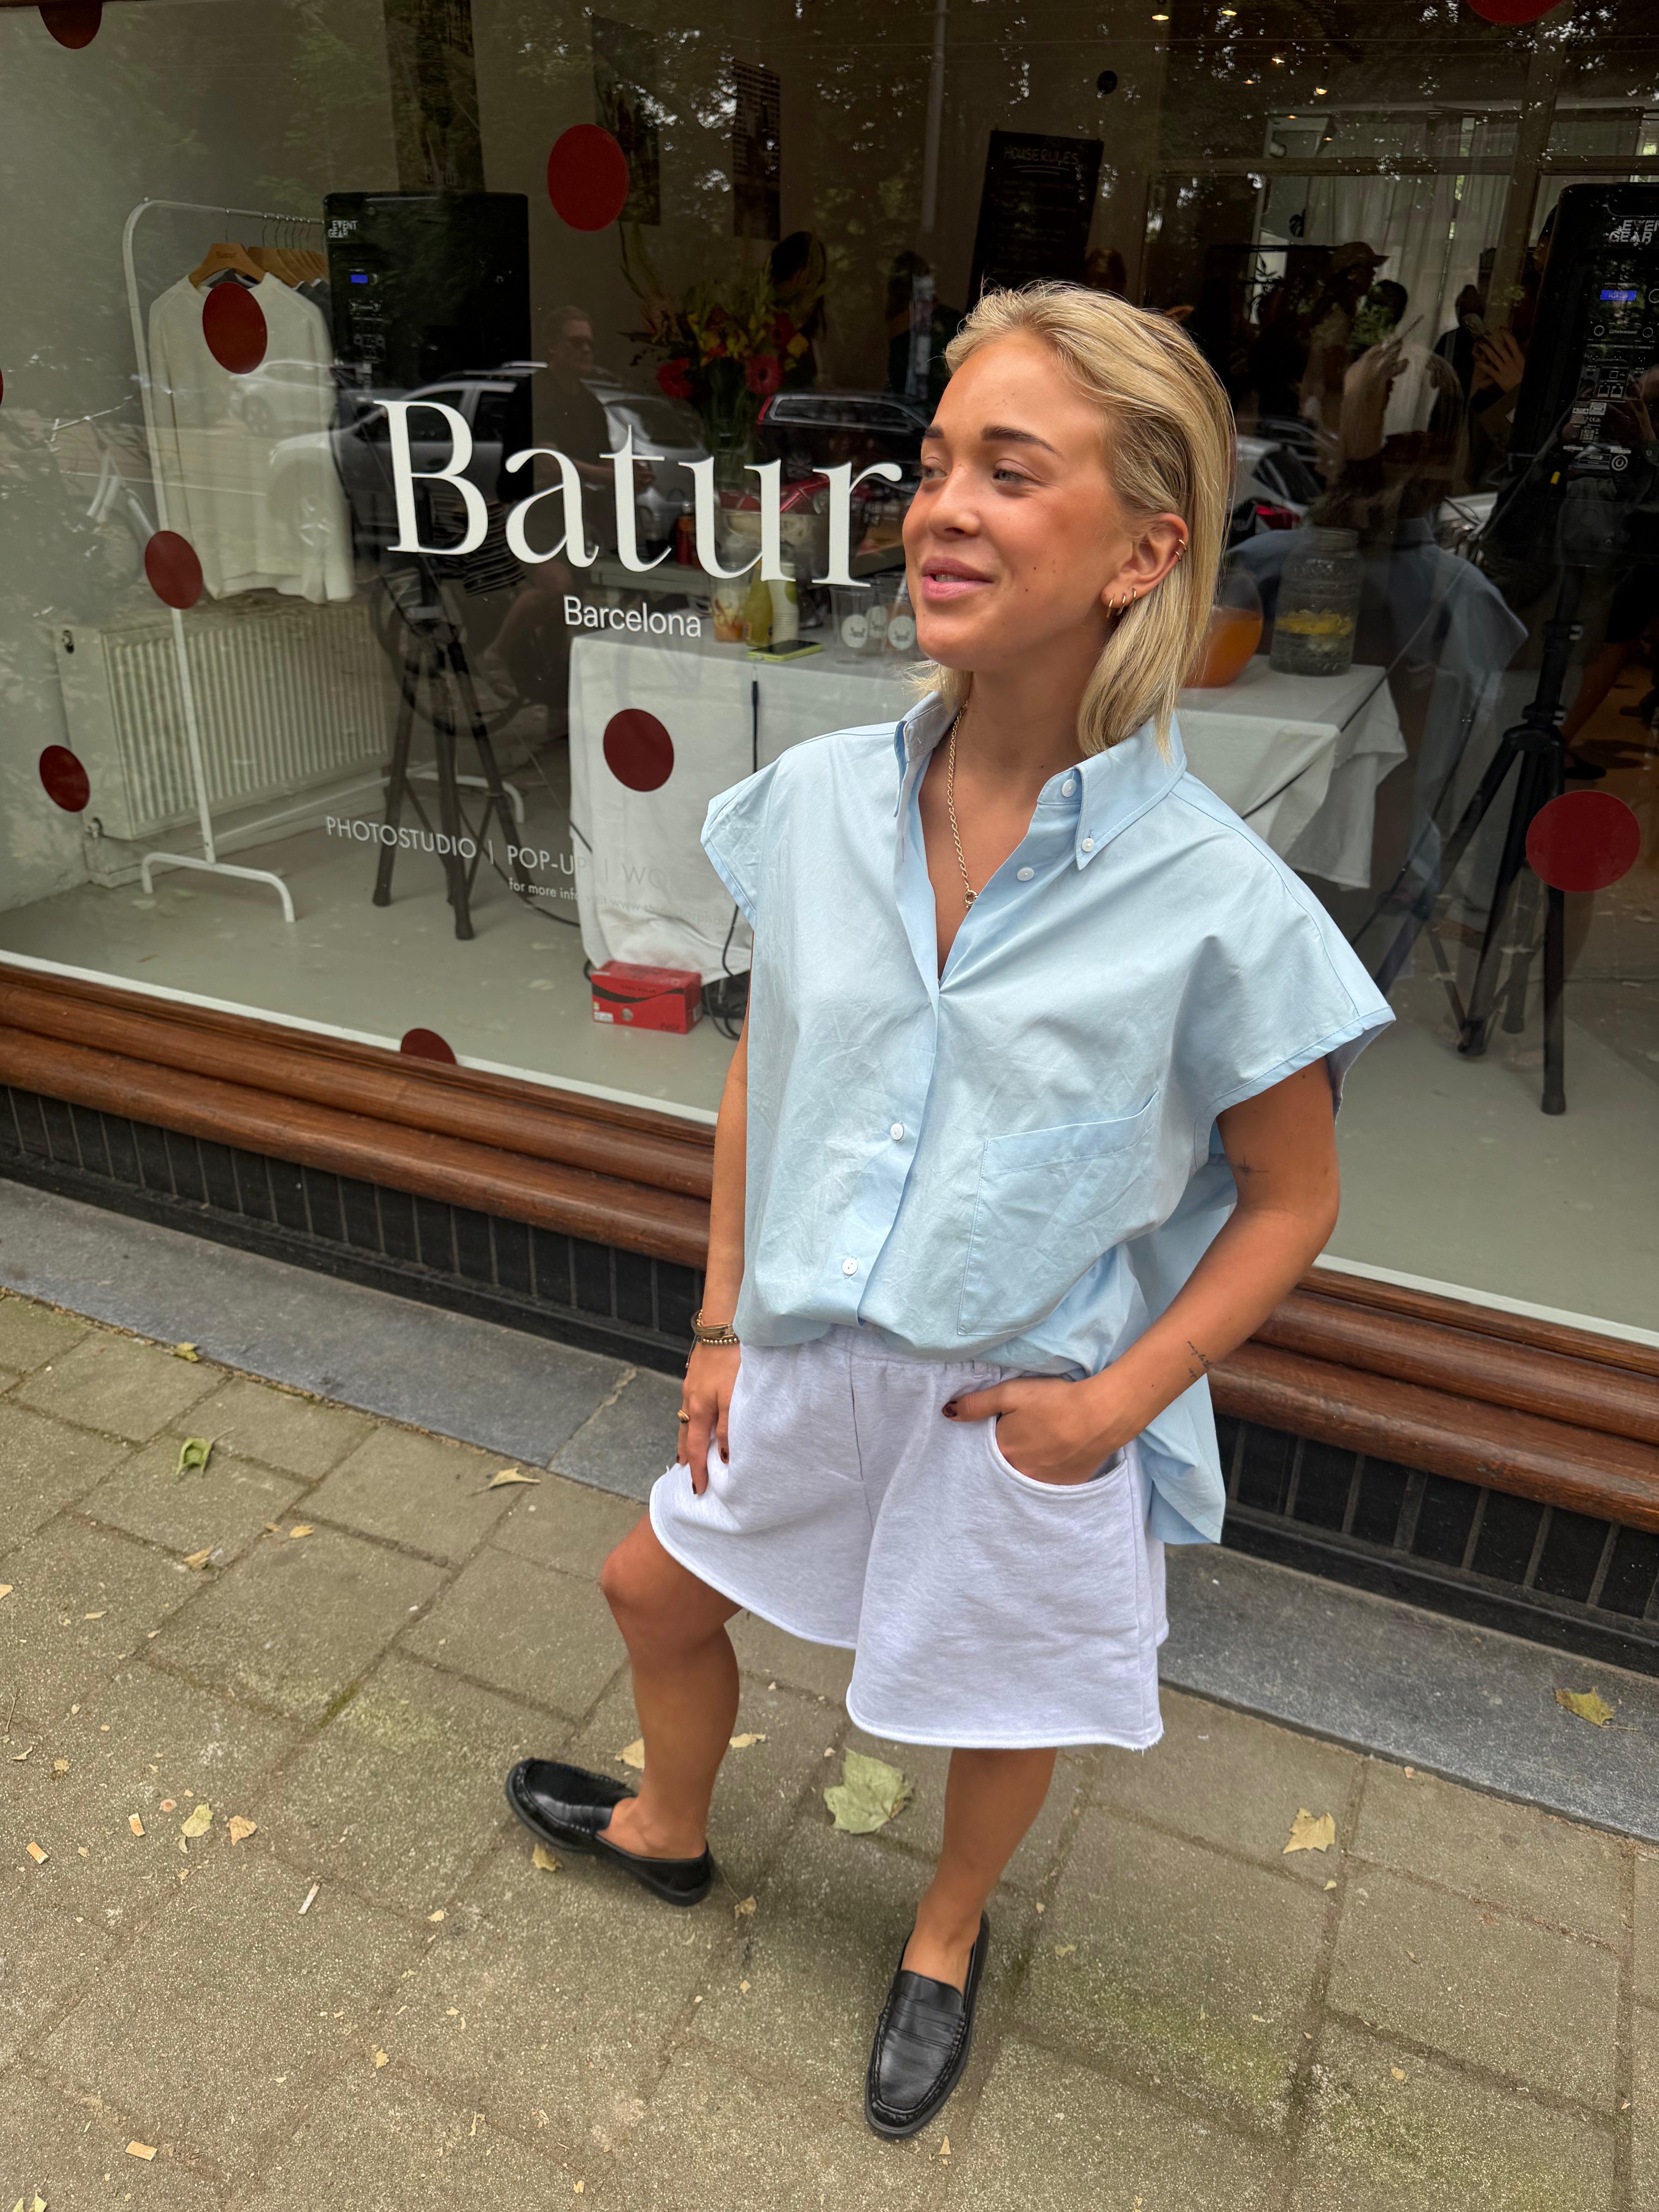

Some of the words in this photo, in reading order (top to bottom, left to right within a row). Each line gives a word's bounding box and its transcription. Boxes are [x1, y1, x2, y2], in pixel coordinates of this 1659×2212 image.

[332, 220, 358, 230] EVENT
[1609, 231, 1652, 243] GEAR
[373, 400, 902, 587] Batur
[563, 594, 701, 637] Barcelona
[326, 816, 477, 858] PHOTOSTUDIO
[507, 844, 587, 878] POP-UP
[508, 877, 526, 892] for
[528, 884, 556, 897] more
